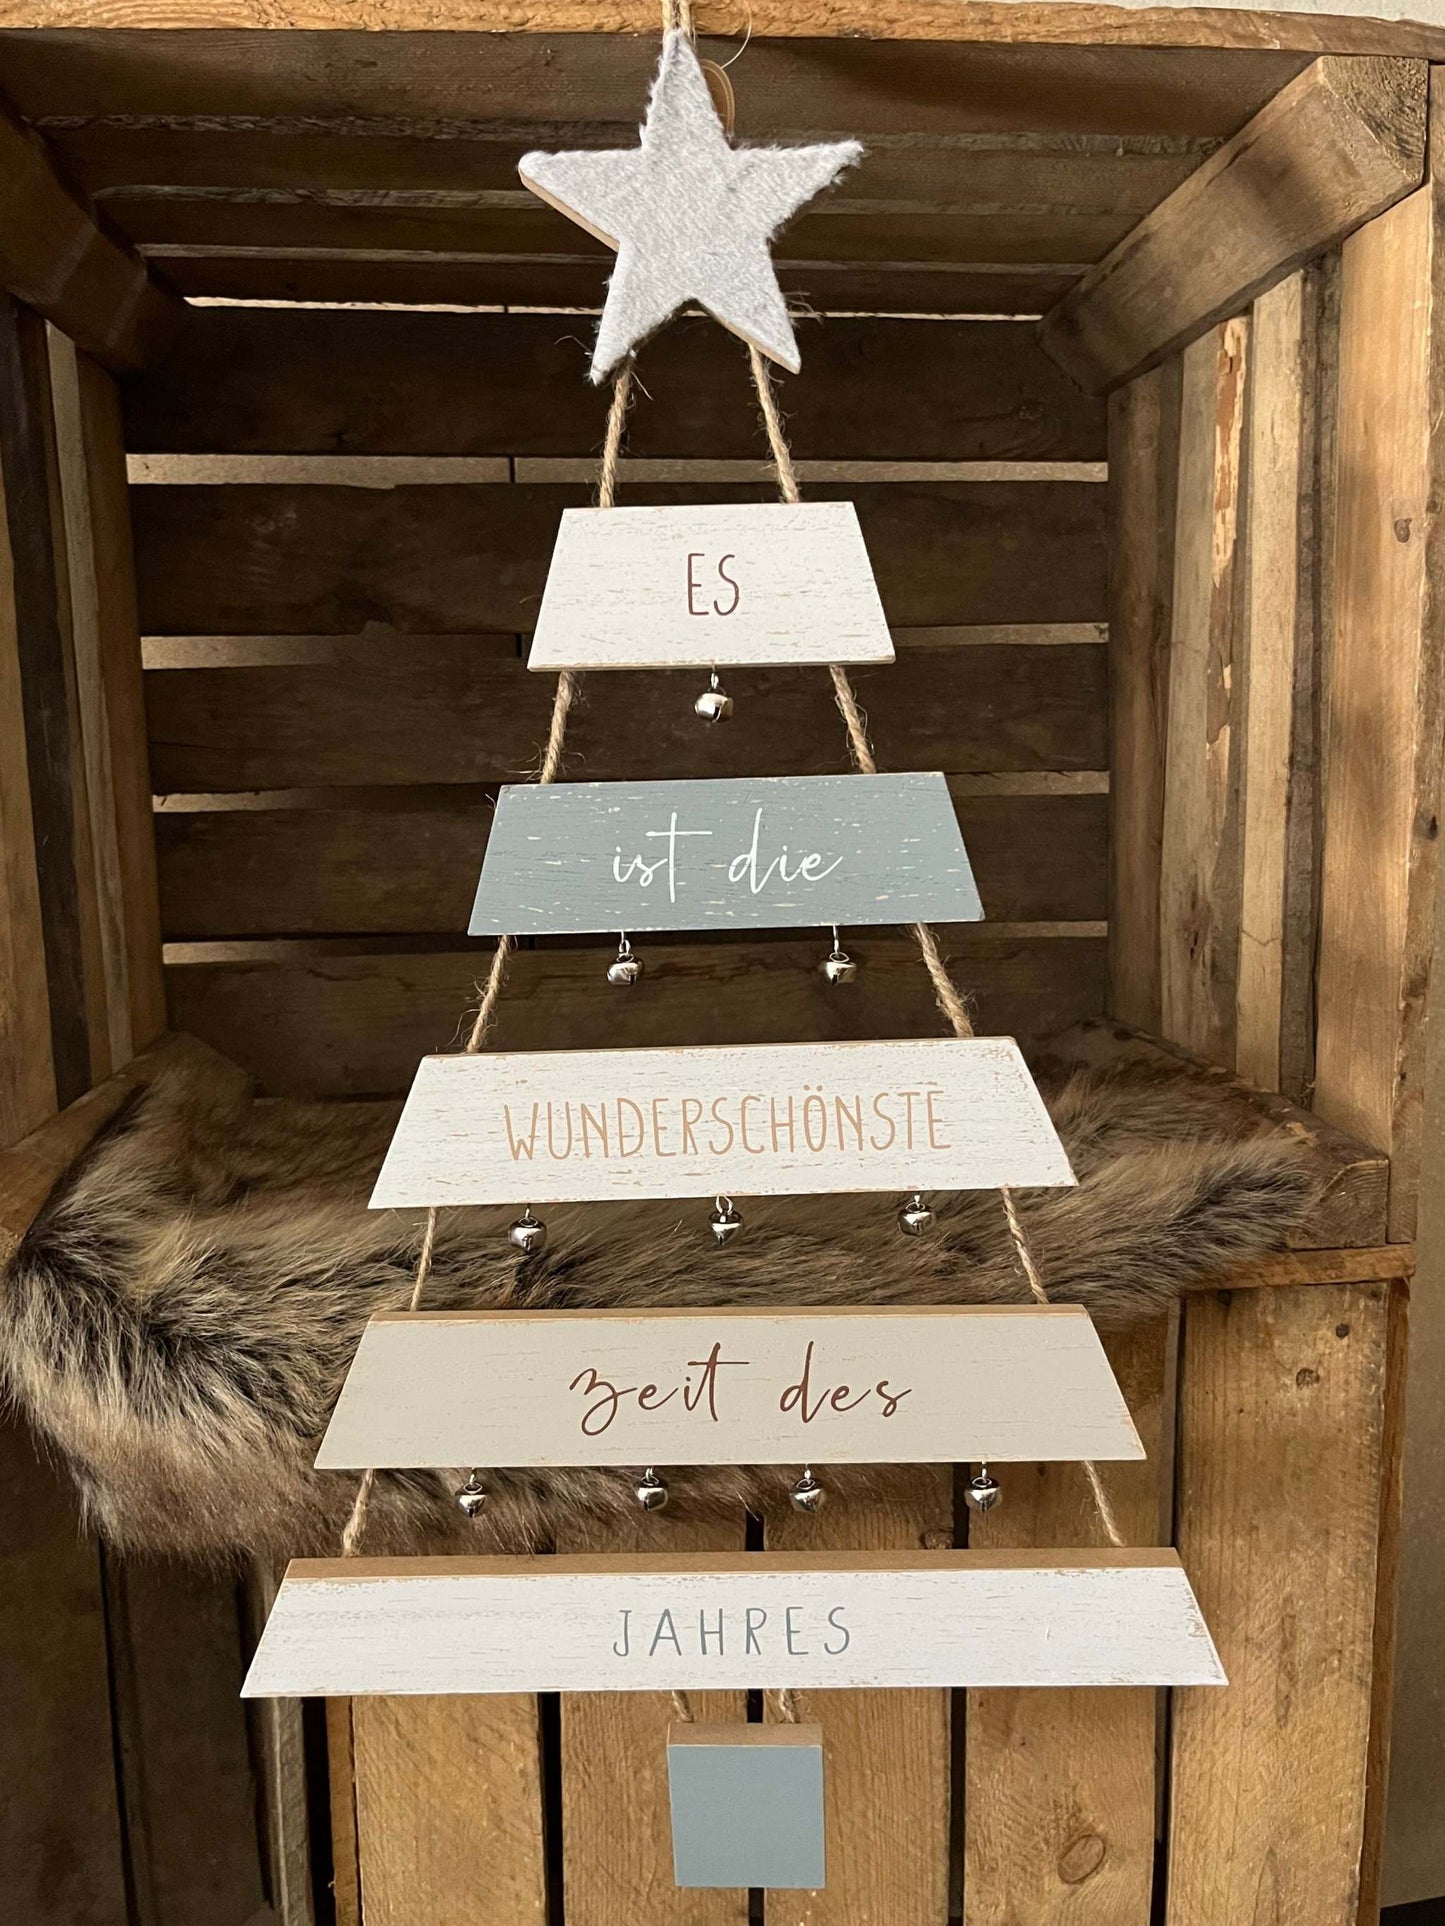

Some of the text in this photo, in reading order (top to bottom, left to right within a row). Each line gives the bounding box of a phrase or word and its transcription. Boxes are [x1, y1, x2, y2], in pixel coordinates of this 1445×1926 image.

[687, 552, 740, 616] ES
[612, 807, 844, 904] ist die
[503, 1084, 952, 1161] WUNDERSCHÖNSTE
[779, 1340, 912, 1423] des
[612, 1606, 850, 1657] JAHRES
